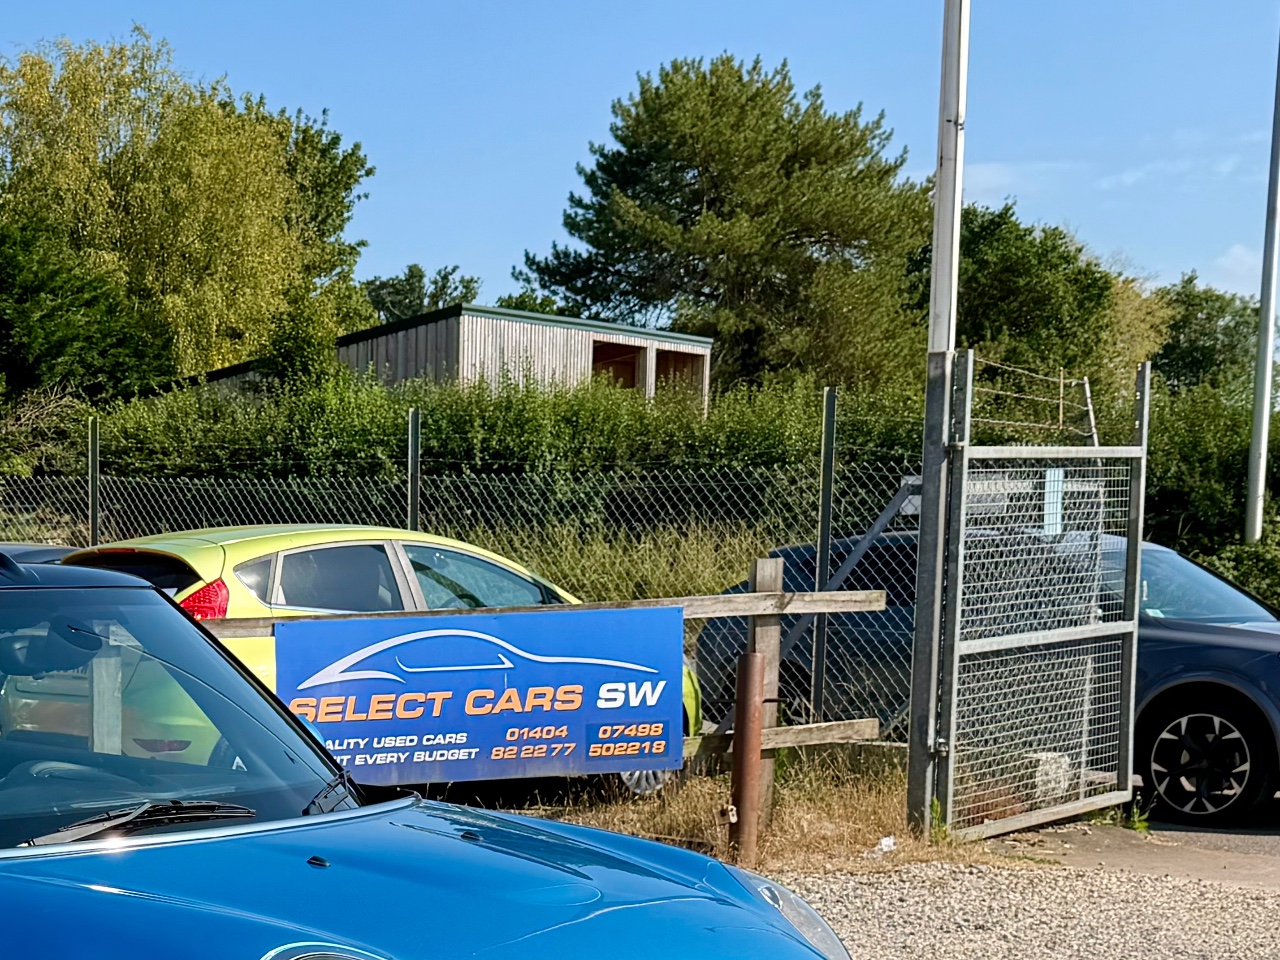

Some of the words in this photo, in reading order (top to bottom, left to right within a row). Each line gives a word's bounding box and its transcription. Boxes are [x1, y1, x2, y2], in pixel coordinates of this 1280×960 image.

[288, 690, 453, 723] SELECT
[464, 684, 584, 716] CARS
[596, 680, 667, 709] SW
[505, 725, 568, 741] 01404
[598, 722, 664, 739] 07498
[325, 737, 369, 751] ALITY
[372, 735, 418, 748] USED
[422, 732, 467, 746] CARS
[588, 740, 666, 757] 502218
[333, 754, 351, 767] IT
[354, 752, 410, 766] EVERY
[413, 748, 479, 762] BUDGET
